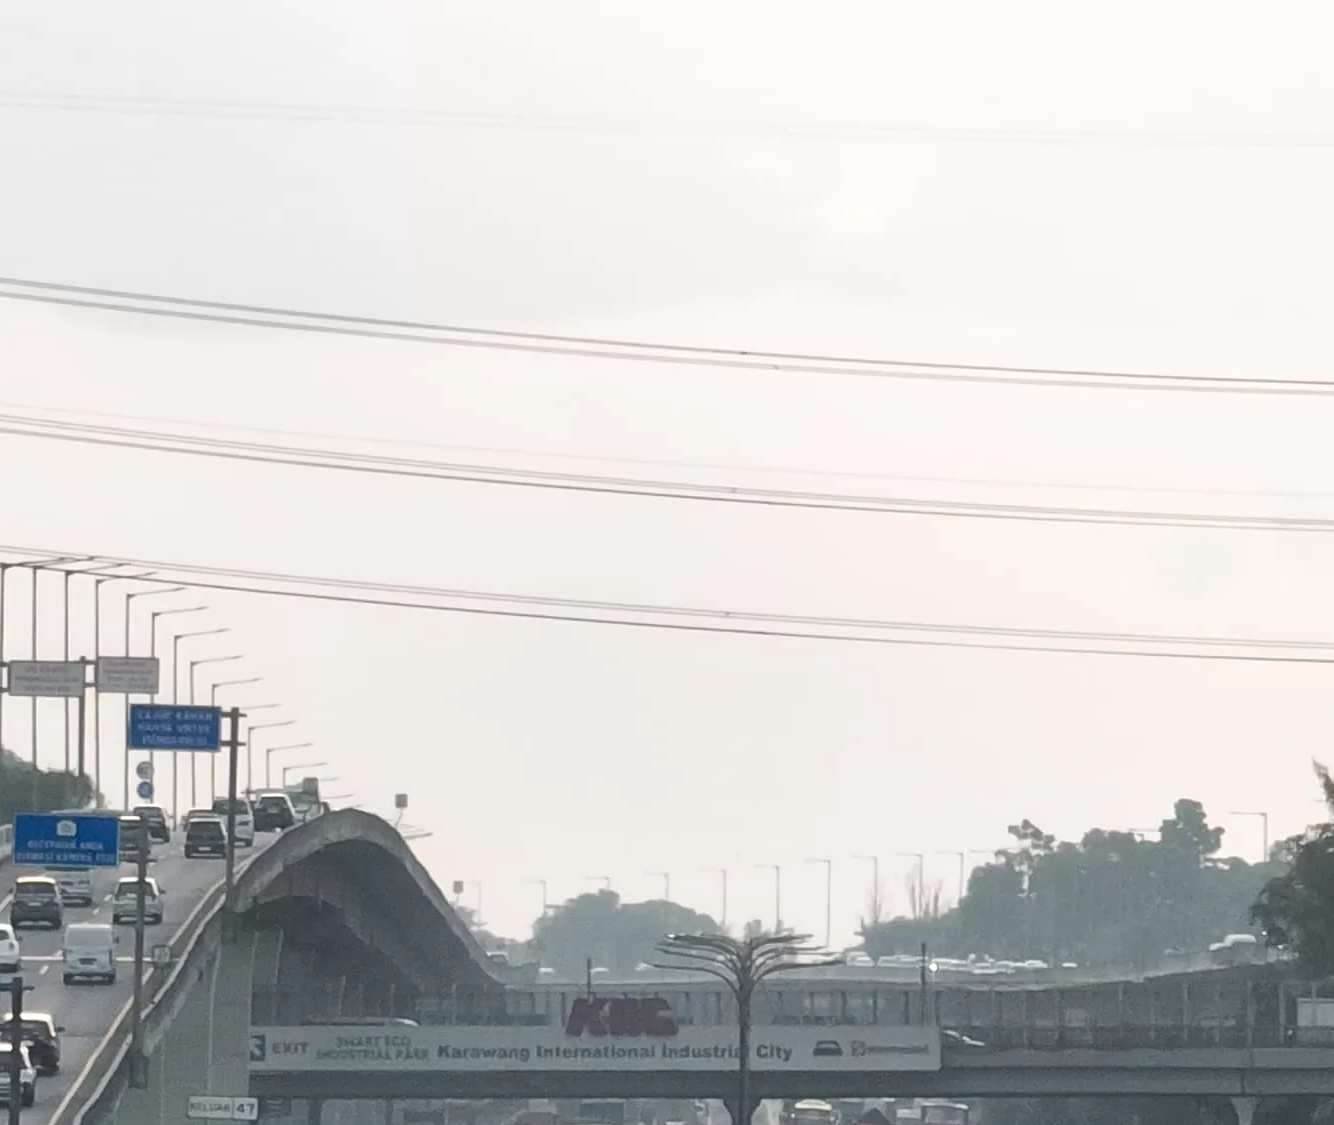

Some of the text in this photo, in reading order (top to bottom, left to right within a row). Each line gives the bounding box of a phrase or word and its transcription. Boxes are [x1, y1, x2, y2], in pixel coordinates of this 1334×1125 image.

[272, 1041, 309, 1055] EXIT
[437, 1042, 793, 1063] Karawang International Industria City
[235, 1102, 256, 1116] 47
